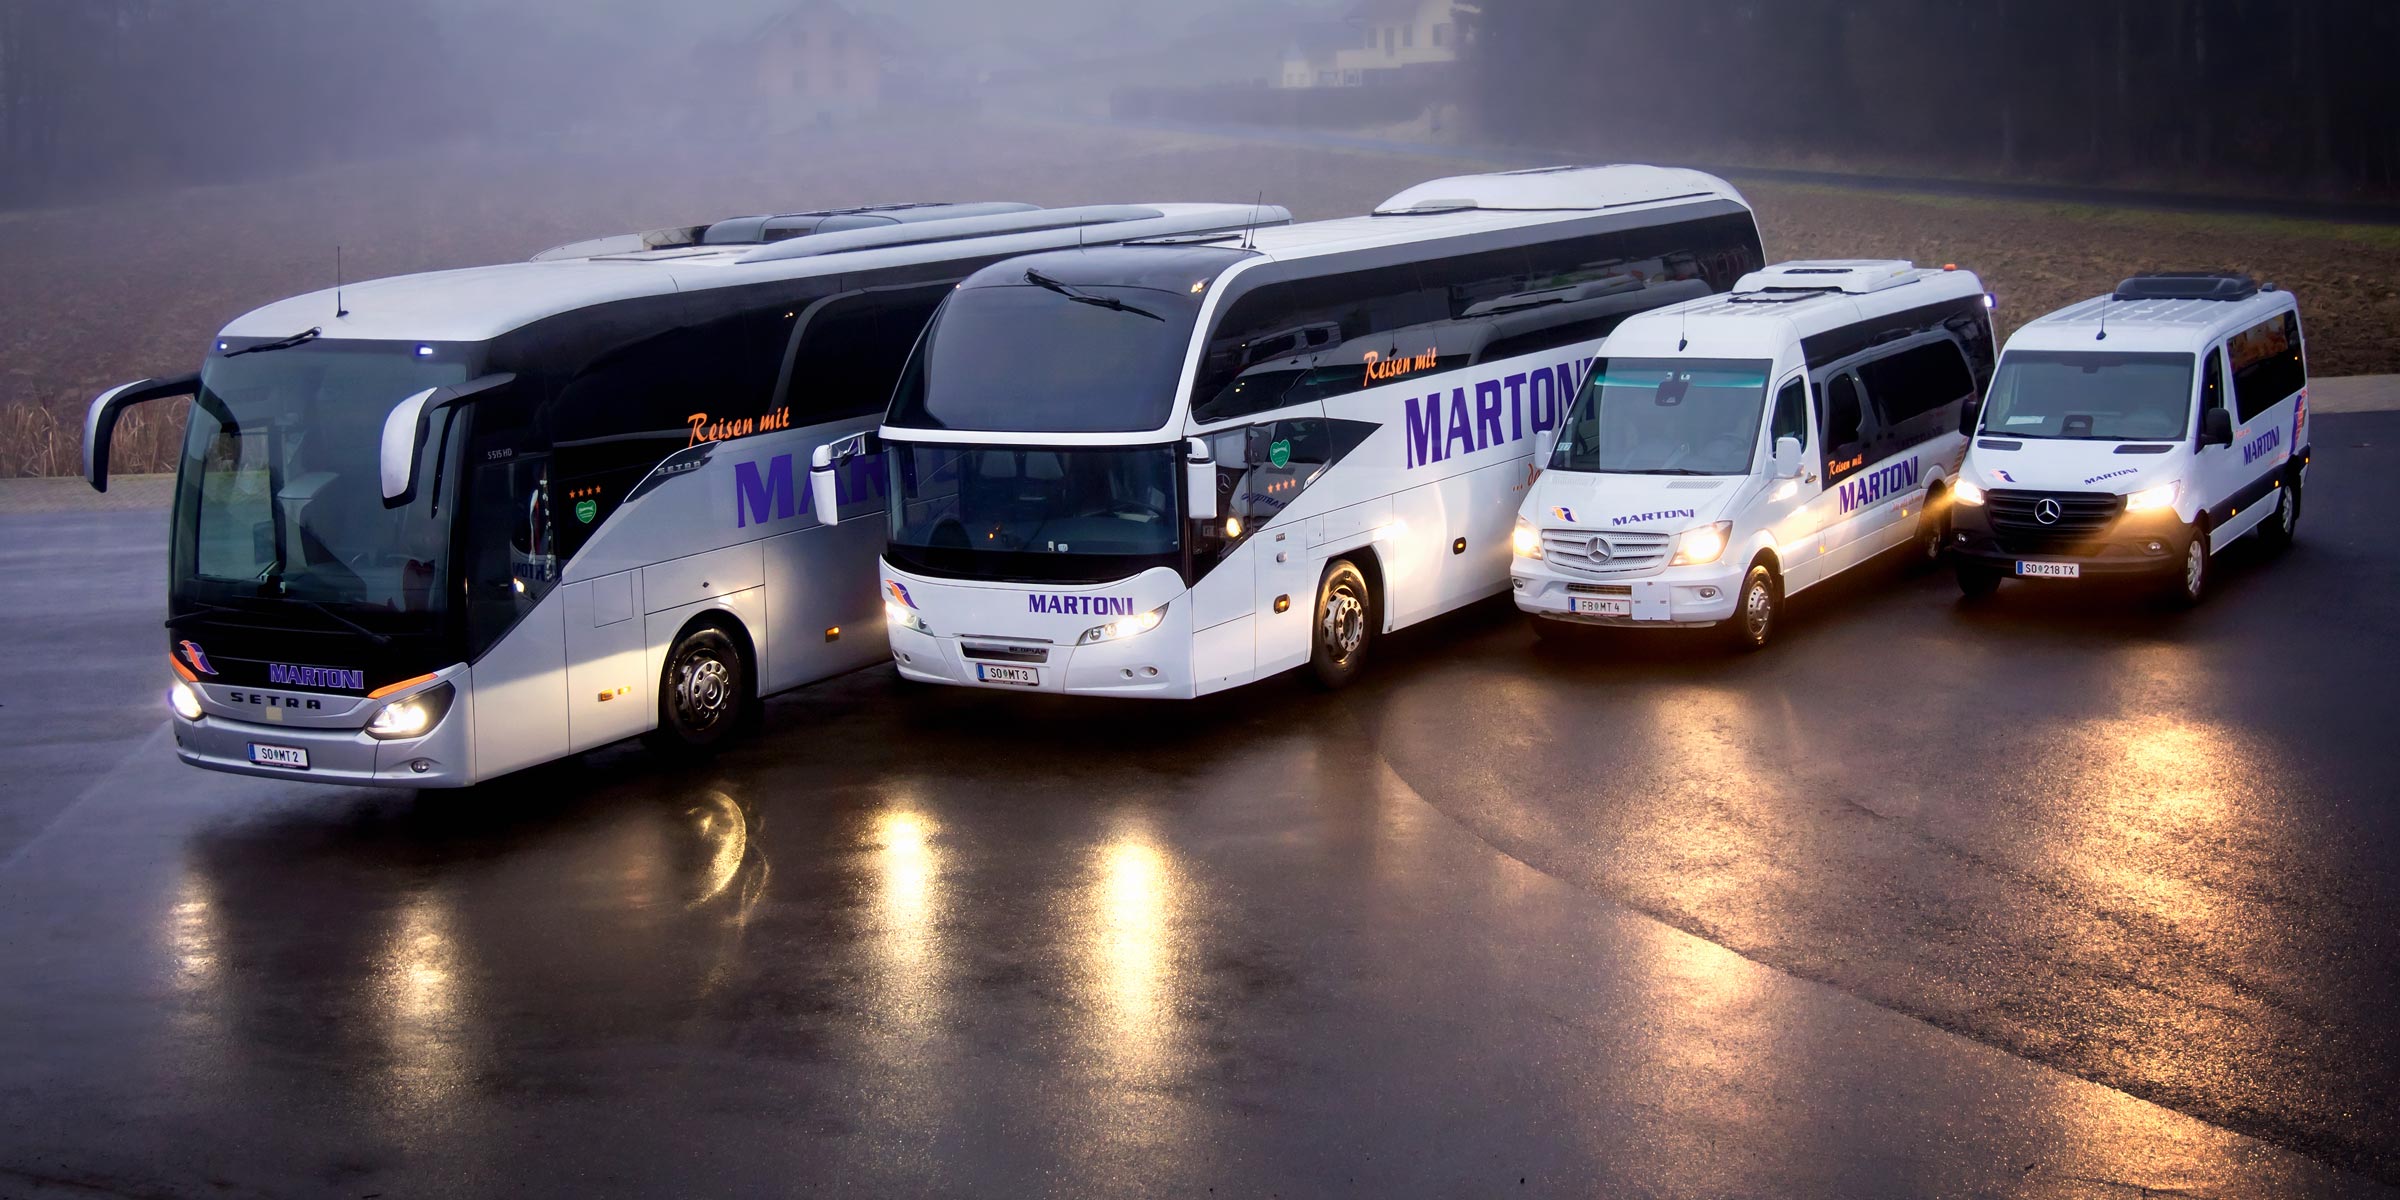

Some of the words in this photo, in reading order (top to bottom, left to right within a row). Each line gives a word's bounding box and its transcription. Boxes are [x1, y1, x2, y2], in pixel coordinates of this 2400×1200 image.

[1363, 350, 1411, 387] Reisen
[1414, 346, 1437, 372] mit
[687, 412, 753, 449] Reisen
[759, 406, 790, 432] mit
[2243, 425, 2280, 466] MARTONI
[1828, 460, 1851, 479] Reisen
[2084, 468, 2138, 485] MARTONI
[1839, 456, 1919, 515] MARTONI
[1612, 509, 1695, 527] MARTONI
[2025, 563, 2037, 574] SO
[2043, 564, 2060, 575] 218
[2062, 566, 2074, 576] TX
[1029, 594, 1134, 616] MARTONI
[1581, 601, 1593, 611] FB
[1600, 602, 1611, 612] MT
[1614, 603, 1620, 612] 4
[270, 664, 364, 689] MARTONI
[990, 668, 1003, 678] SO
[1008, 670, 1020, 681] MT
[1023, 671, 1029, 681] 3
[231, 692, 321, 709] SETRA
[261, 748, 273, 760] SO
[279, 751, 291, 762] MT
[292, 751, 299, 763] 2
